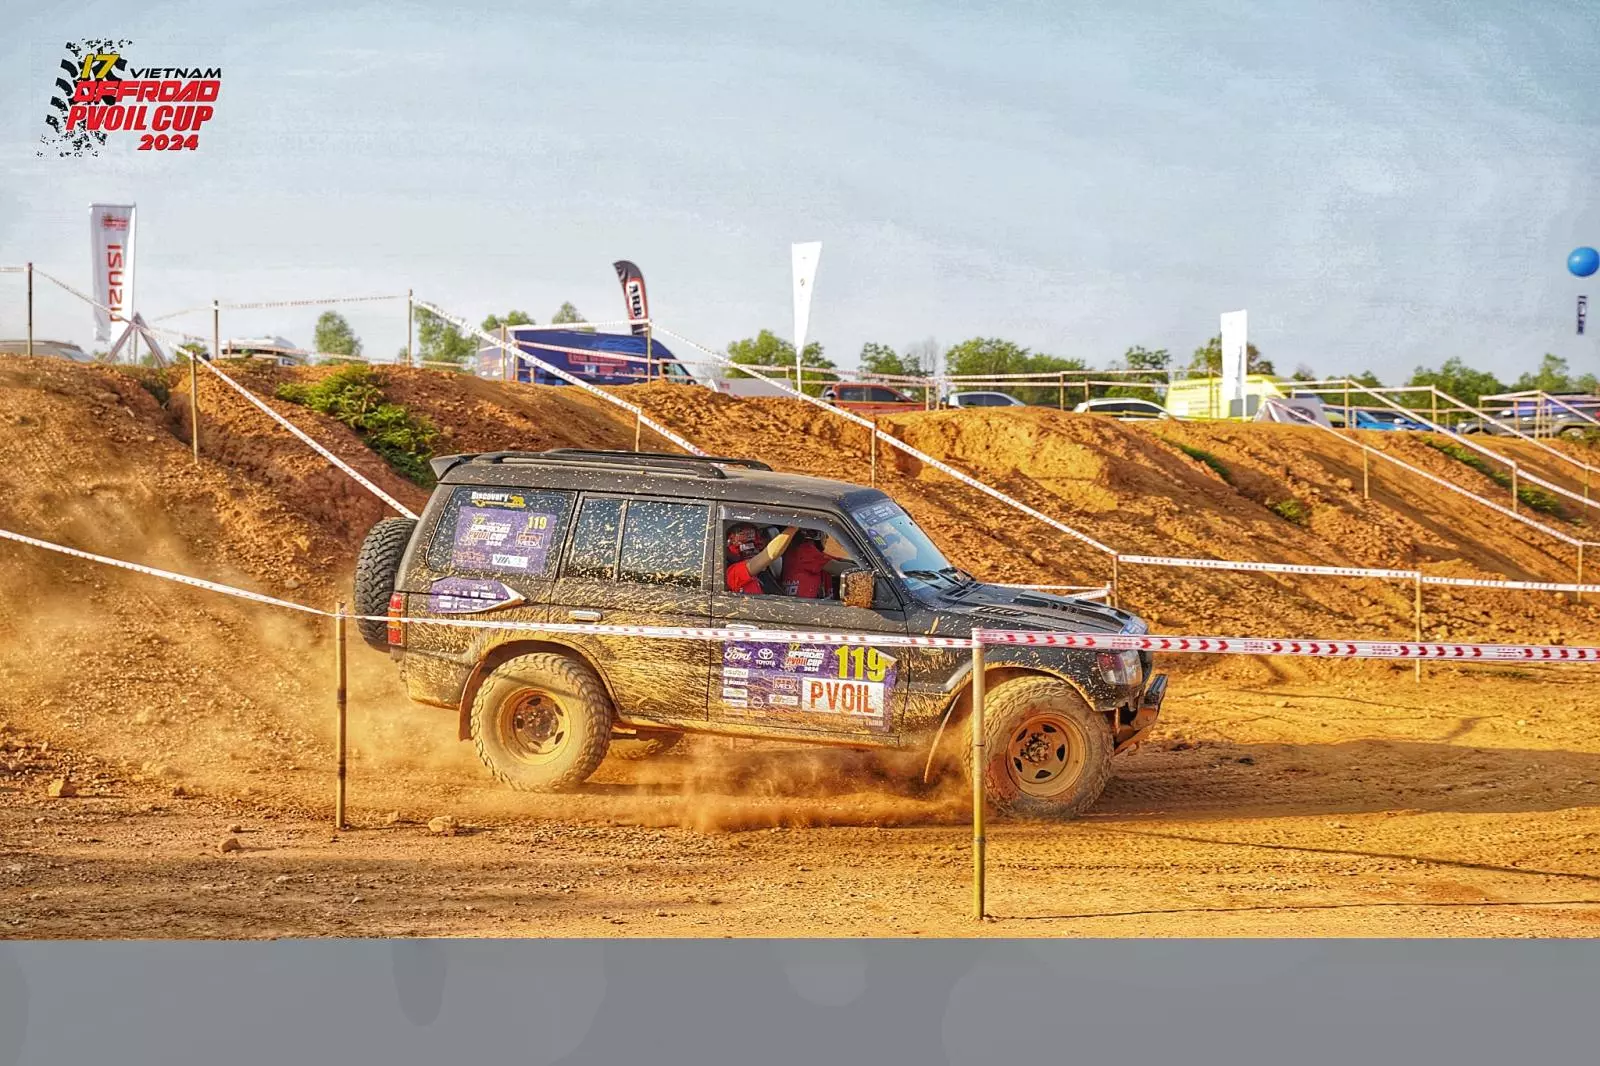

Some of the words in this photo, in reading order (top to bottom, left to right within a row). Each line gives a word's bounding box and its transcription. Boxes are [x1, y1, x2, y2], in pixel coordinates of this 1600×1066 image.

[107, 244, 123, 323] ISUZU
[629, 283, 642, 317] ARB
[528, 516, 547, 530] 119
[724, 645, 752, 661] Ford
[756, 659, 776, 667] TOYOTA
[807, 659, 823, 667] CUP
[835, 645, 886, 682] 119
[810, 681, 875, 714] PVOIL
